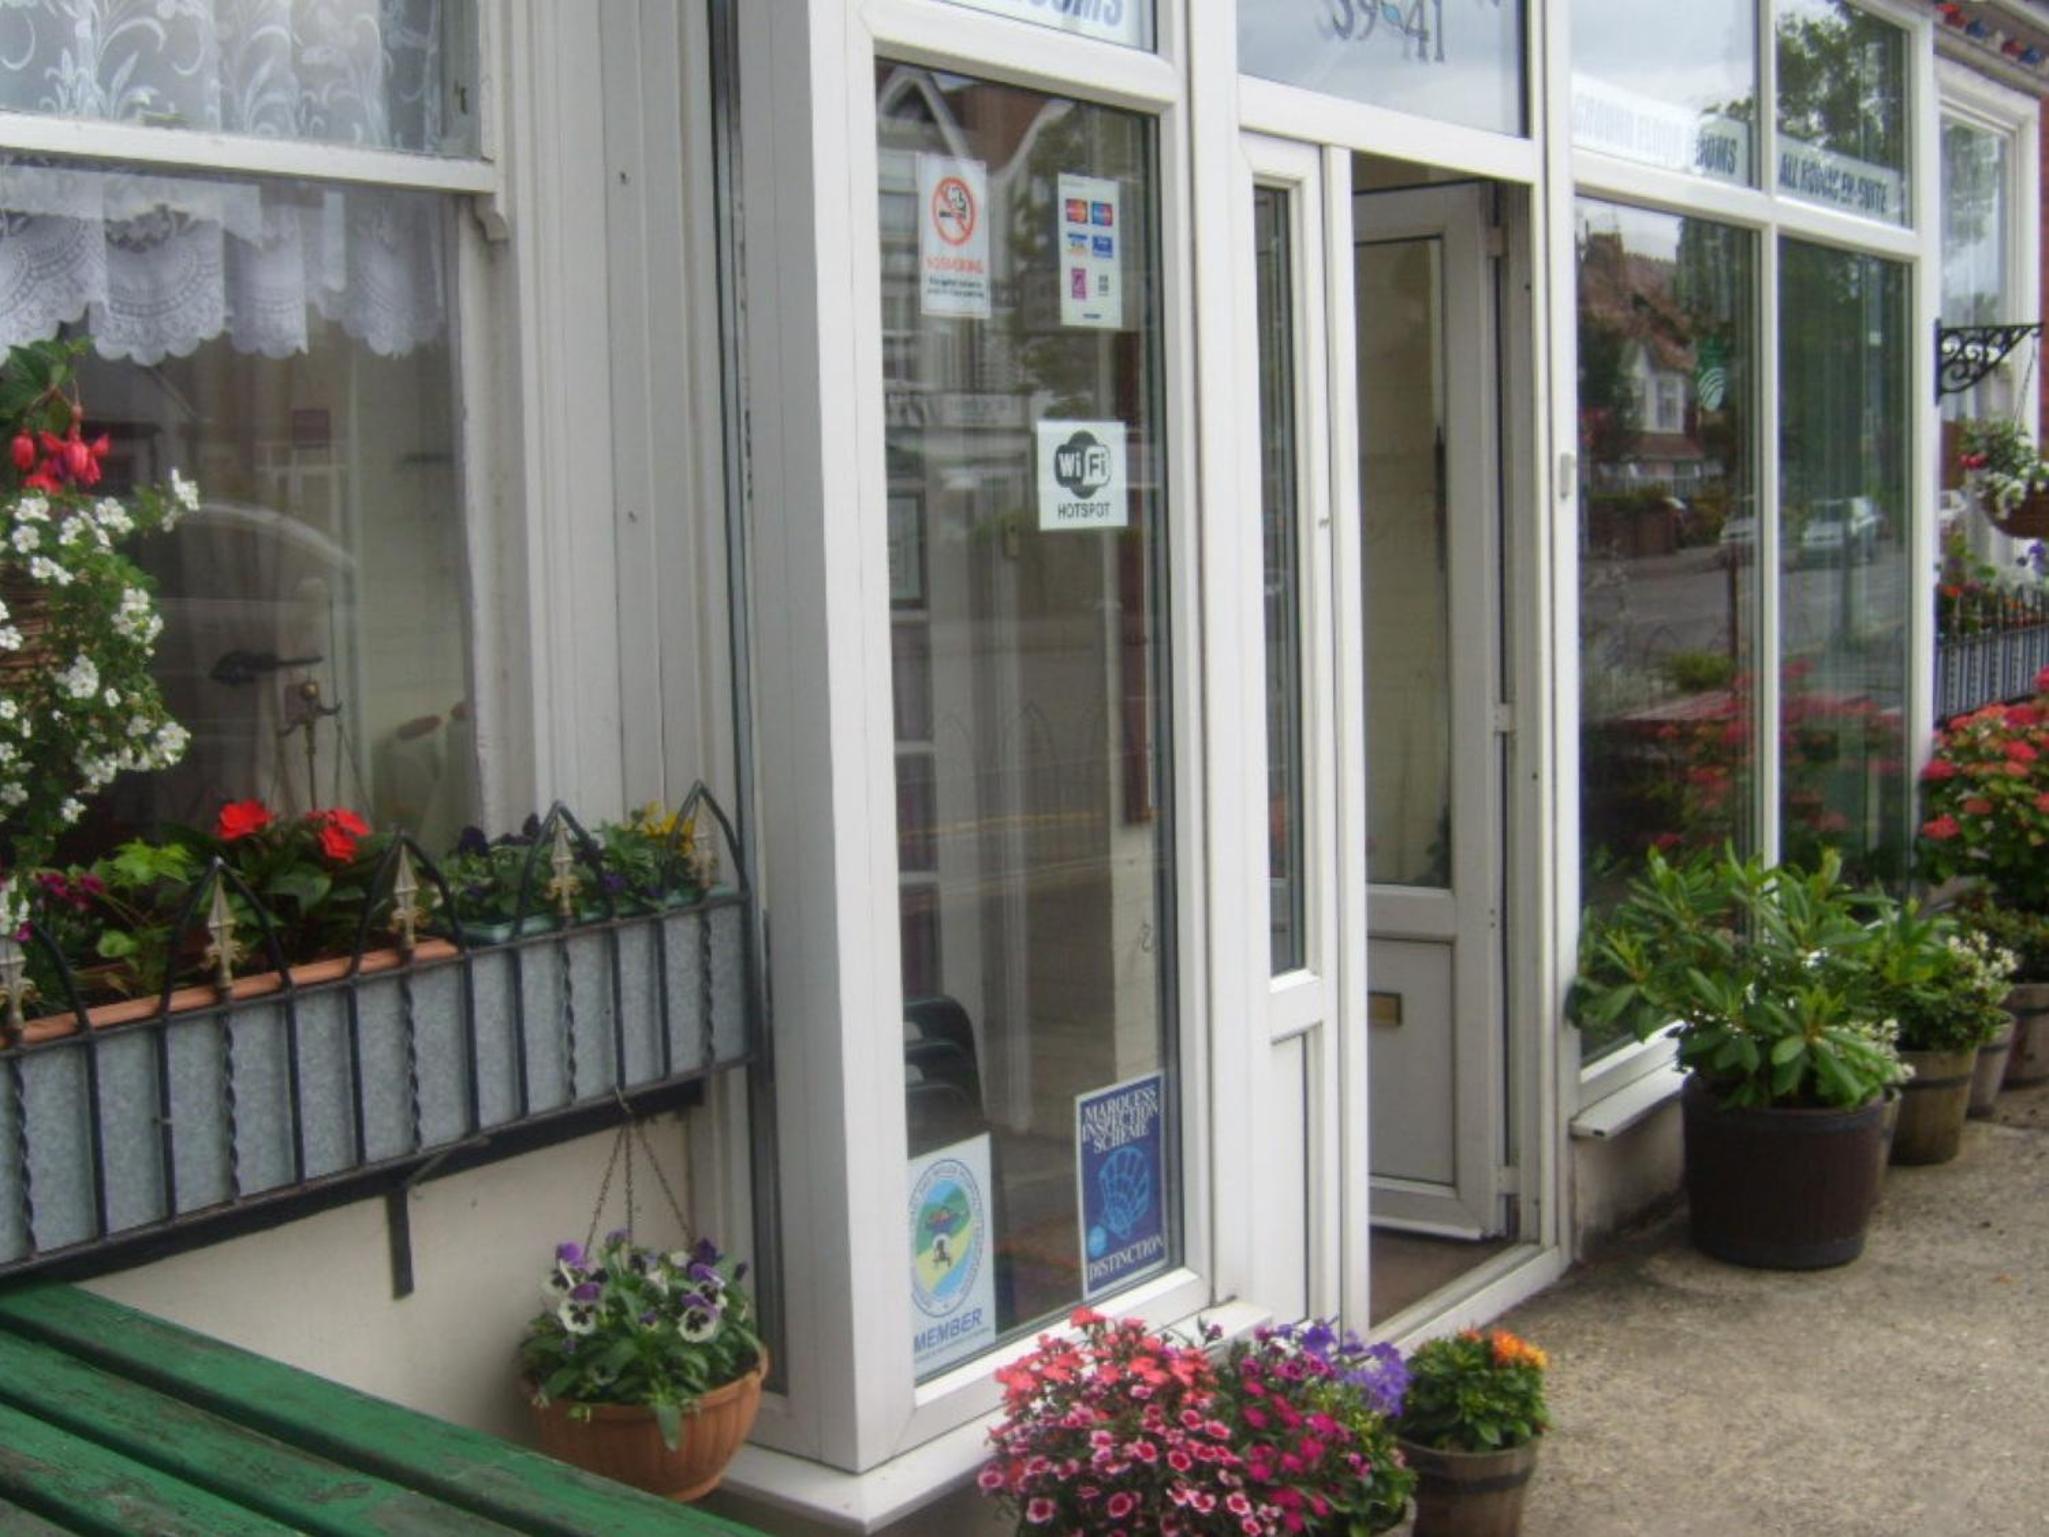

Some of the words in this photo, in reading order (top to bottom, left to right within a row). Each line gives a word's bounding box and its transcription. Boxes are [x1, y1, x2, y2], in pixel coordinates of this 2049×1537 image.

[1056, 502, 1110, 520] HOTSPOT
[1093, 1123, 1149, 1154] SCHEME
[1089, 1234, 1165, 1281] DISTINCTION
[914, 1307, 983, 1354] MEMBER
